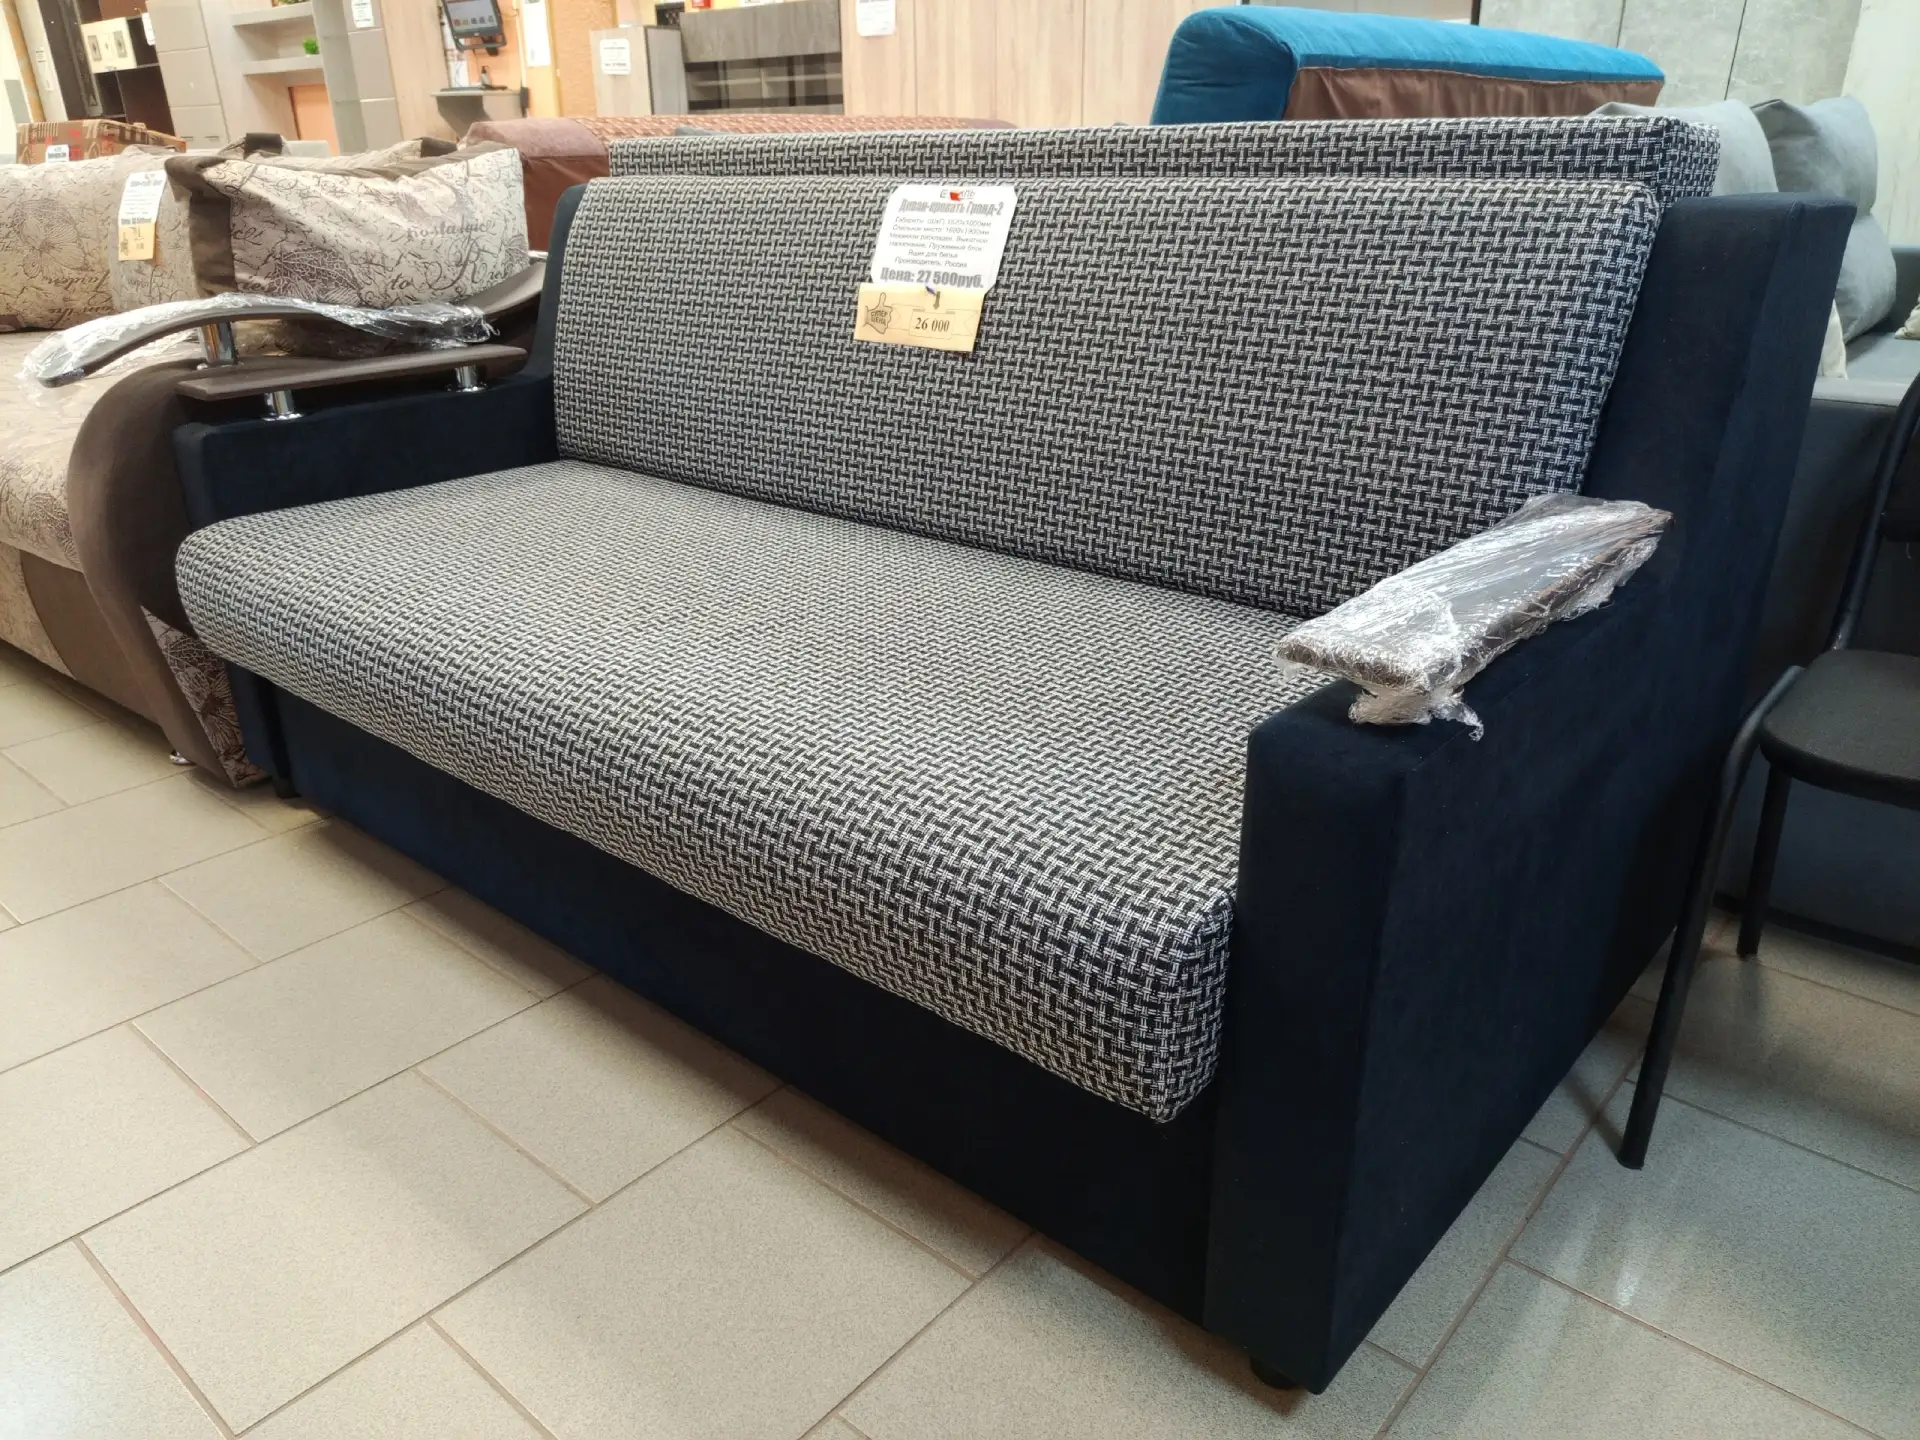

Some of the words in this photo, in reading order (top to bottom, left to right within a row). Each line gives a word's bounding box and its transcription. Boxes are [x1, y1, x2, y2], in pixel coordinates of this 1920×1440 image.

[898, 198, 965, 214] Диван-кровать
[966, 200, 1004, 217] Гранд-2
[880, 267, 915, 283] Цена:
[916, 270, 932, 284] 27
[933, 271, 985, 289] 500руб.
[915, 317, 931, 330] 26
[931, 319, 950, 332] 000
